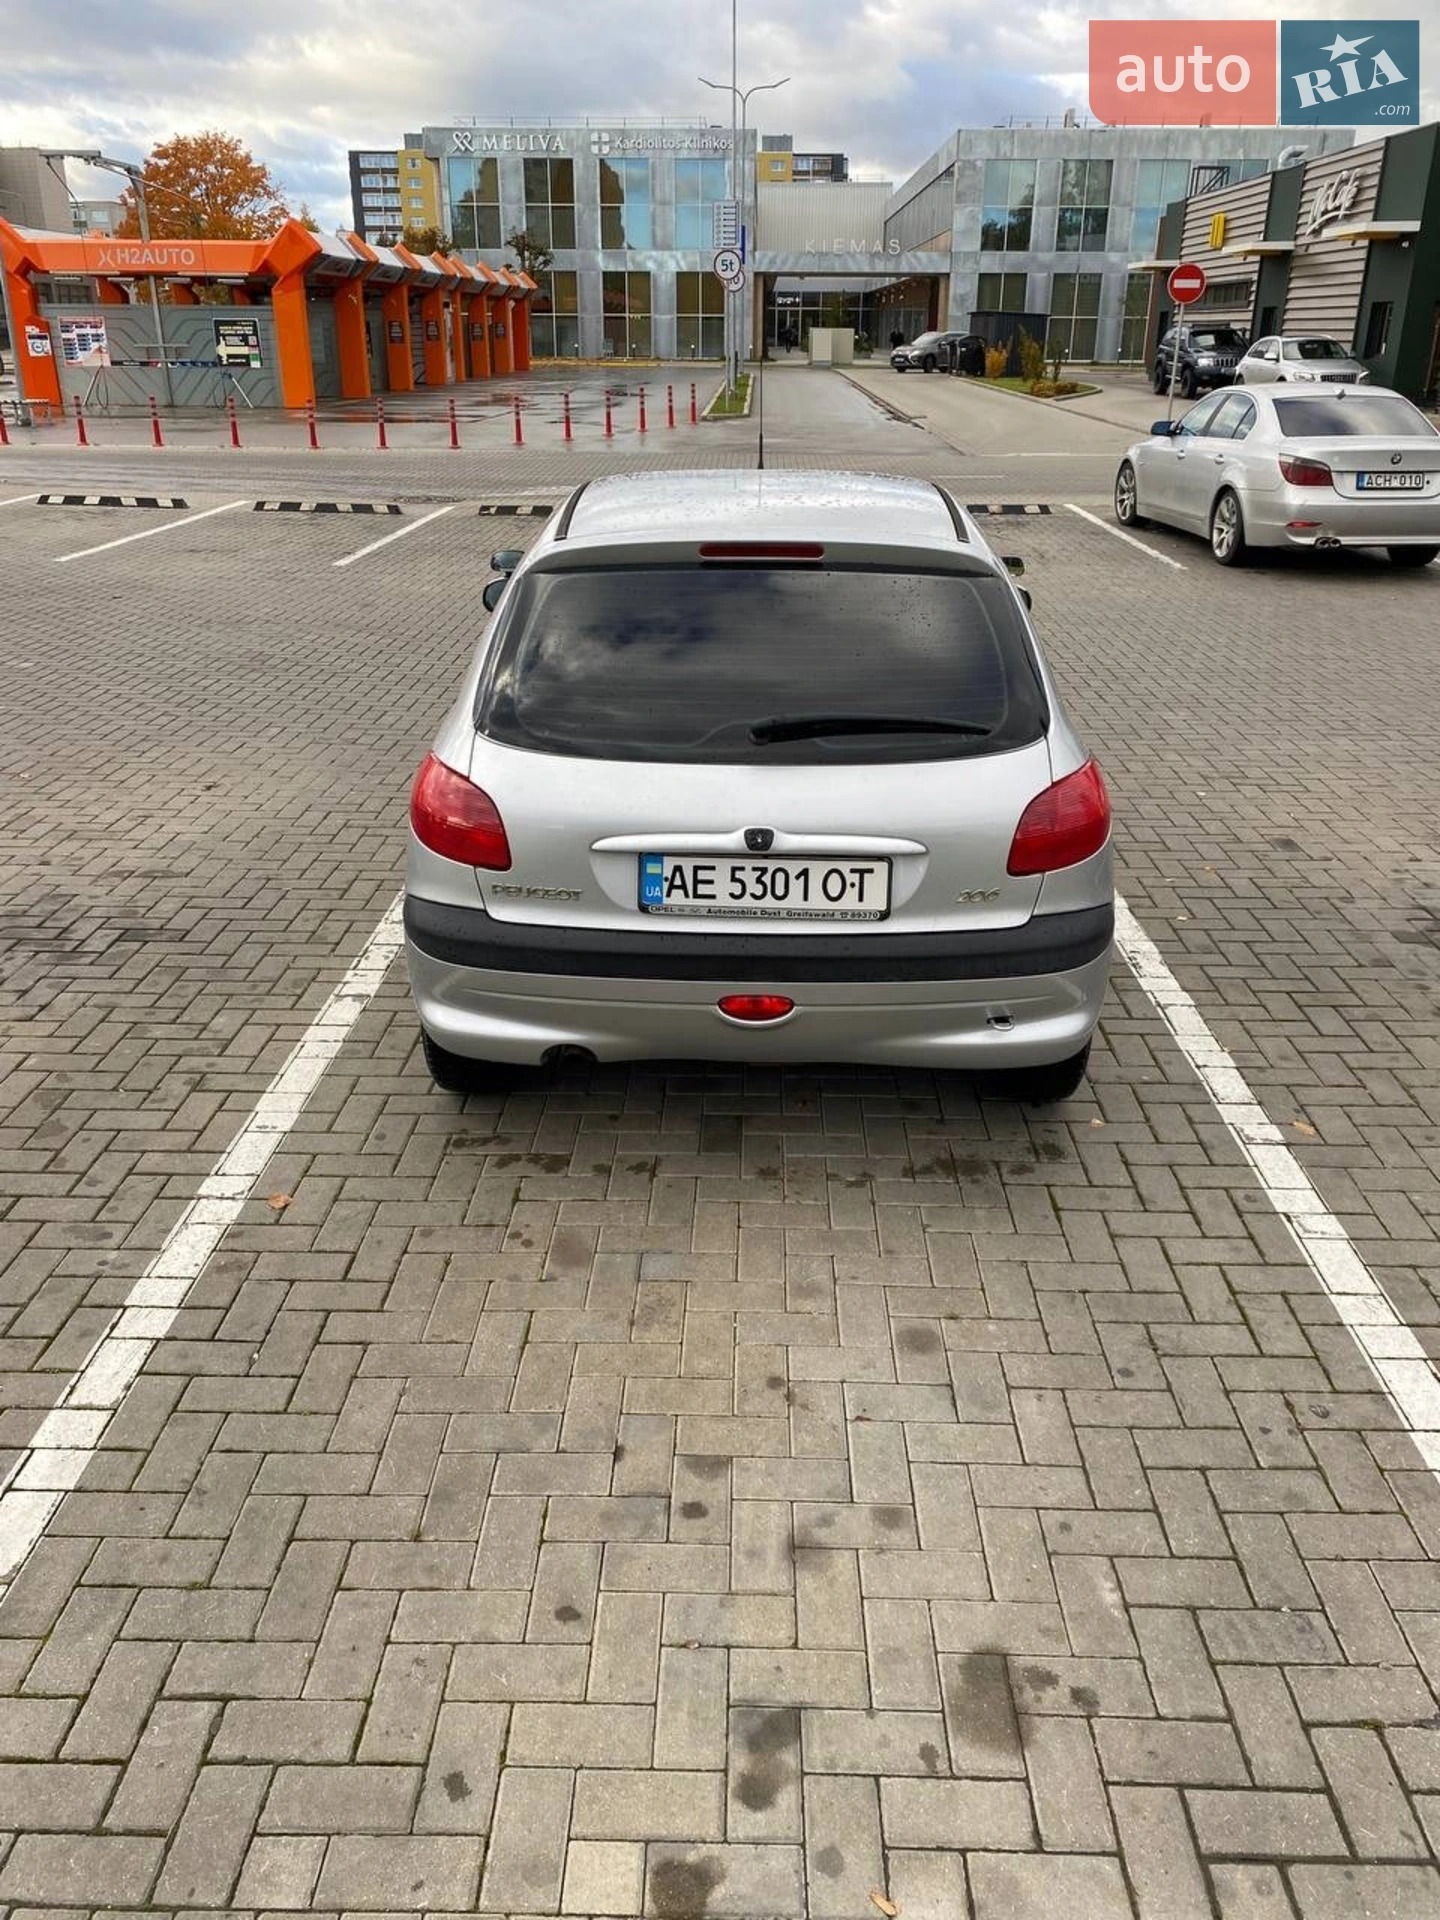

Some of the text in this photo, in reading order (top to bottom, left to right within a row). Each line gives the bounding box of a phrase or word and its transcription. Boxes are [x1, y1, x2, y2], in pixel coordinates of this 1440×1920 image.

[482, 134, 565, 151] MELIVA
[615, 136, 733, 150] Kardiolitos Klinikos
[805, 239, 901, 255] KIEMAS
[721, 259, 735, 272] 5t
[1367, 475, 1422, 486] ACH 010
[665, 865, 875, 902] AE 5301 OT
[491, 883, 583, 900] PEUGEOT
[645, 886, 661, 897] UA
[955, 887, 1001, 903] 206
[649, 905, 675, 913] OPEL
[706, 907, 757, 916] Automobile
[760, 909, 781, 917] Dust
[785, 910, 835, 919] Greifswald
